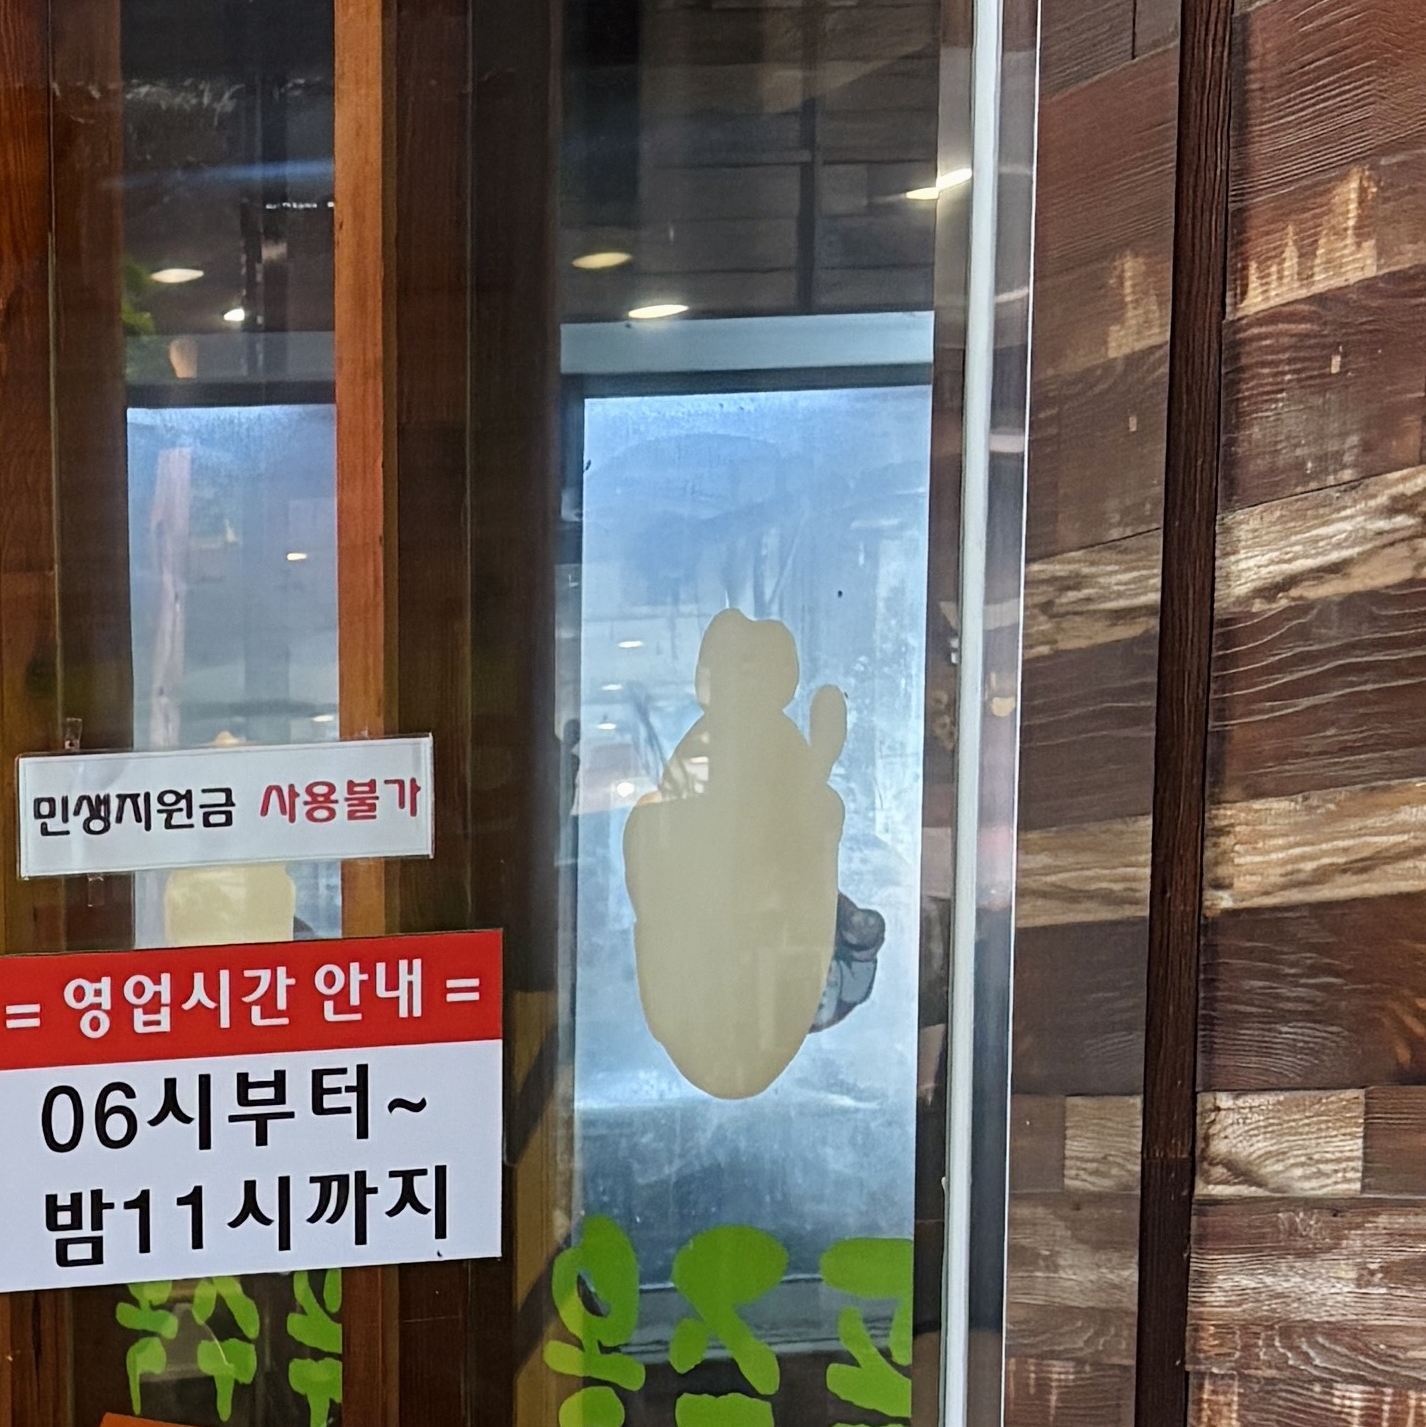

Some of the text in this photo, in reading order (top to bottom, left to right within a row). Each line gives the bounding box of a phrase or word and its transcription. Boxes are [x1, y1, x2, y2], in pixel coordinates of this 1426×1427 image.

[33, 777, 422, 837] 민생지원금 사용불가
[63, 966, 296, 1040] 영업시간
[314, 958, 423, 1022] 안내
[41, 1063, 428, 1154] 06시부터~
[45, 1165, 448, 1268] 밤11시까지
